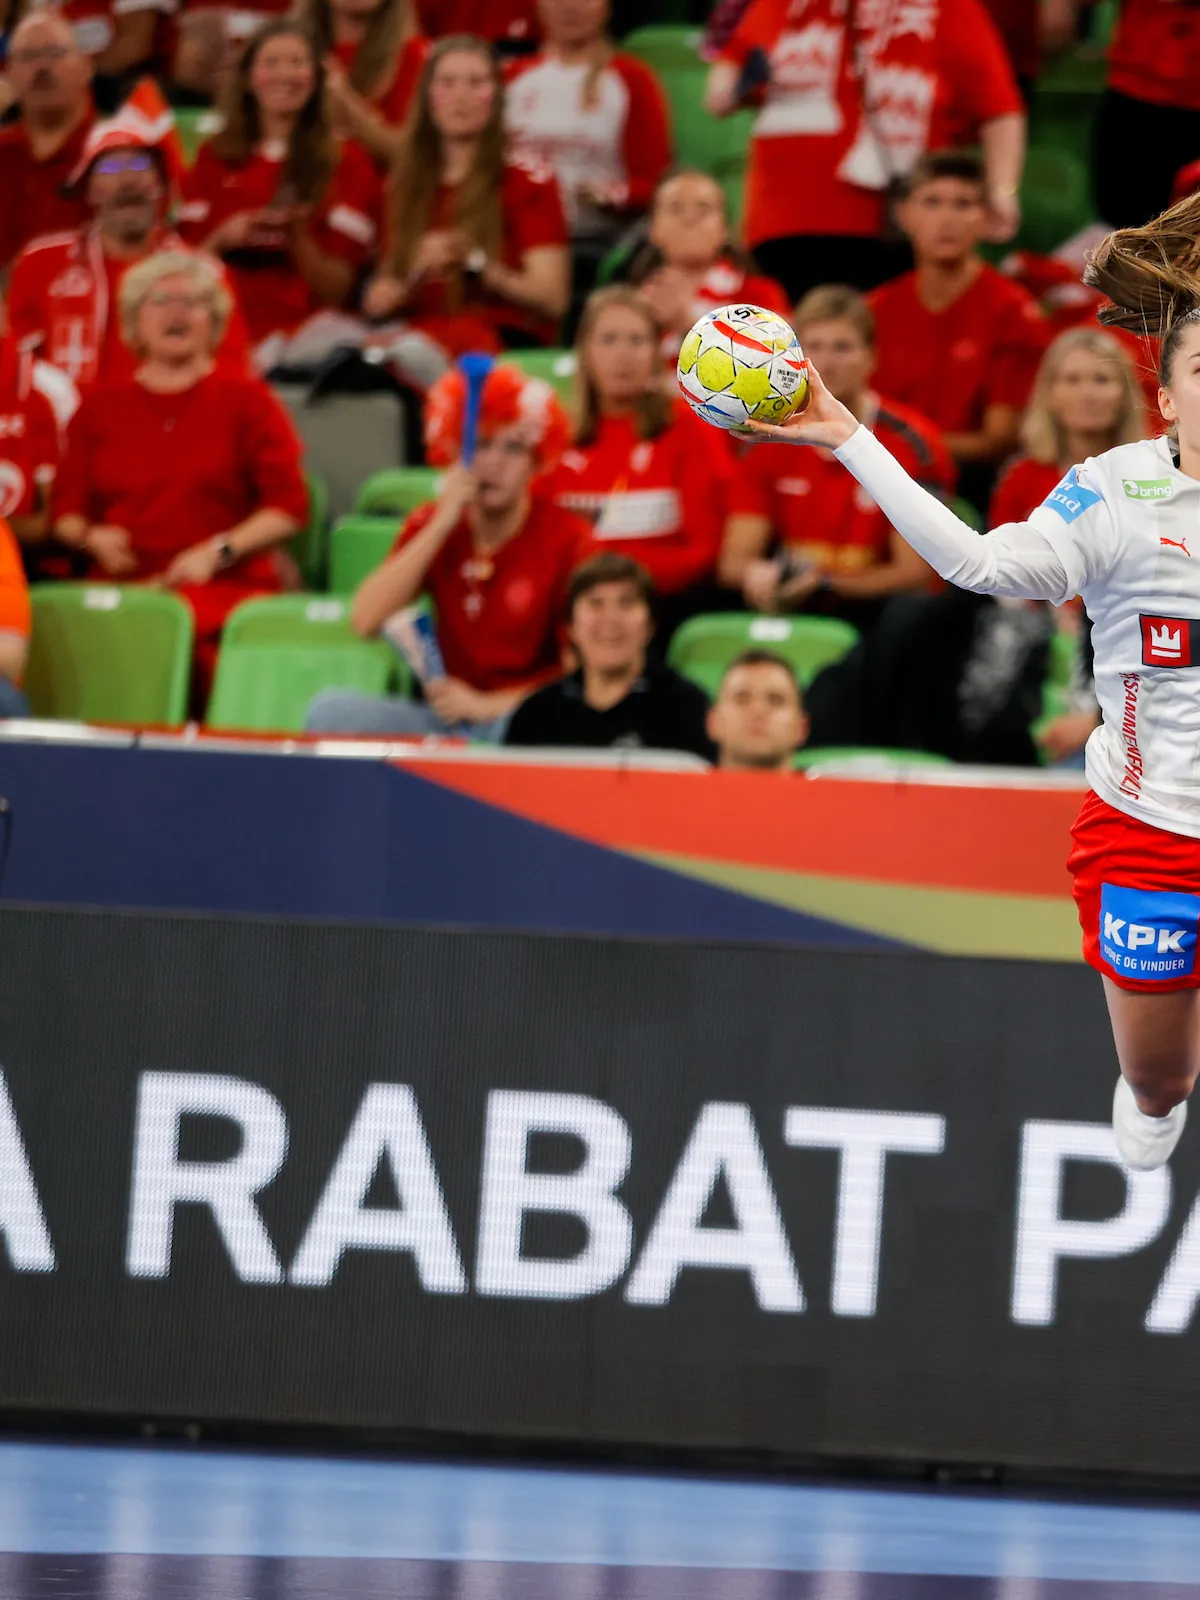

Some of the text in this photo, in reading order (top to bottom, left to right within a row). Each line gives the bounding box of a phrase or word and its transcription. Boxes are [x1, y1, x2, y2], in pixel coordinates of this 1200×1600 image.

[1139, 483, 1173, 498] bring
[1103, 911, 1188, 954] KPK
[1123, 956, 1138, 970] OG
[1140, 958, 1185, 972] VINDUER
[125, 1070, 947, 1318] RABAT
